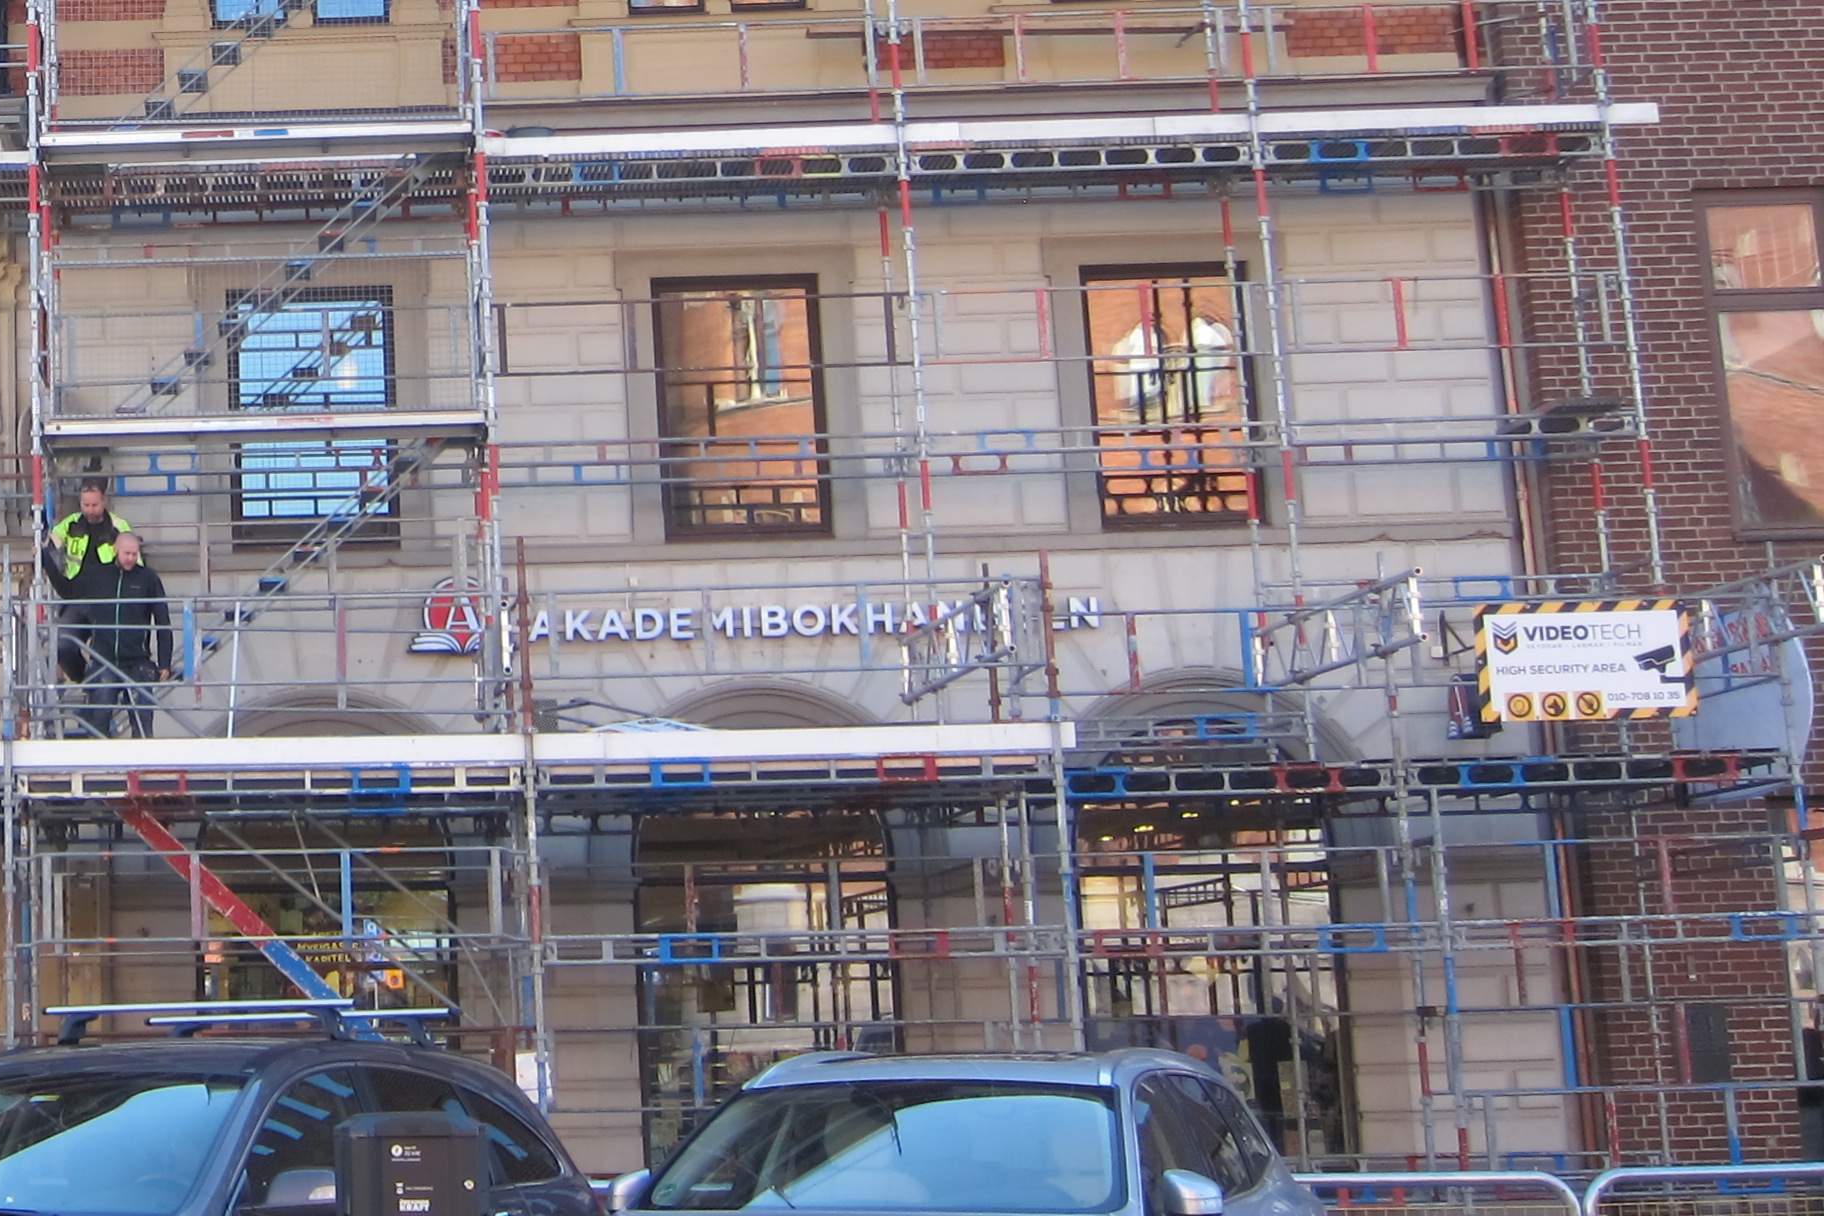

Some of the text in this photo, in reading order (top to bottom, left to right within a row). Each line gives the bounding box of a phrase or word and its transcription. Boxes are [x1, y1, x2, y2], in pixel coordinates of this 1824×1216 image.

[1523, 623, 1642, 641] VIDEOTECH
[1496, 663, 1626, 675] HIGH SECURITY AREA
[1607, 690, 1681, 701] 010-708 10 35
